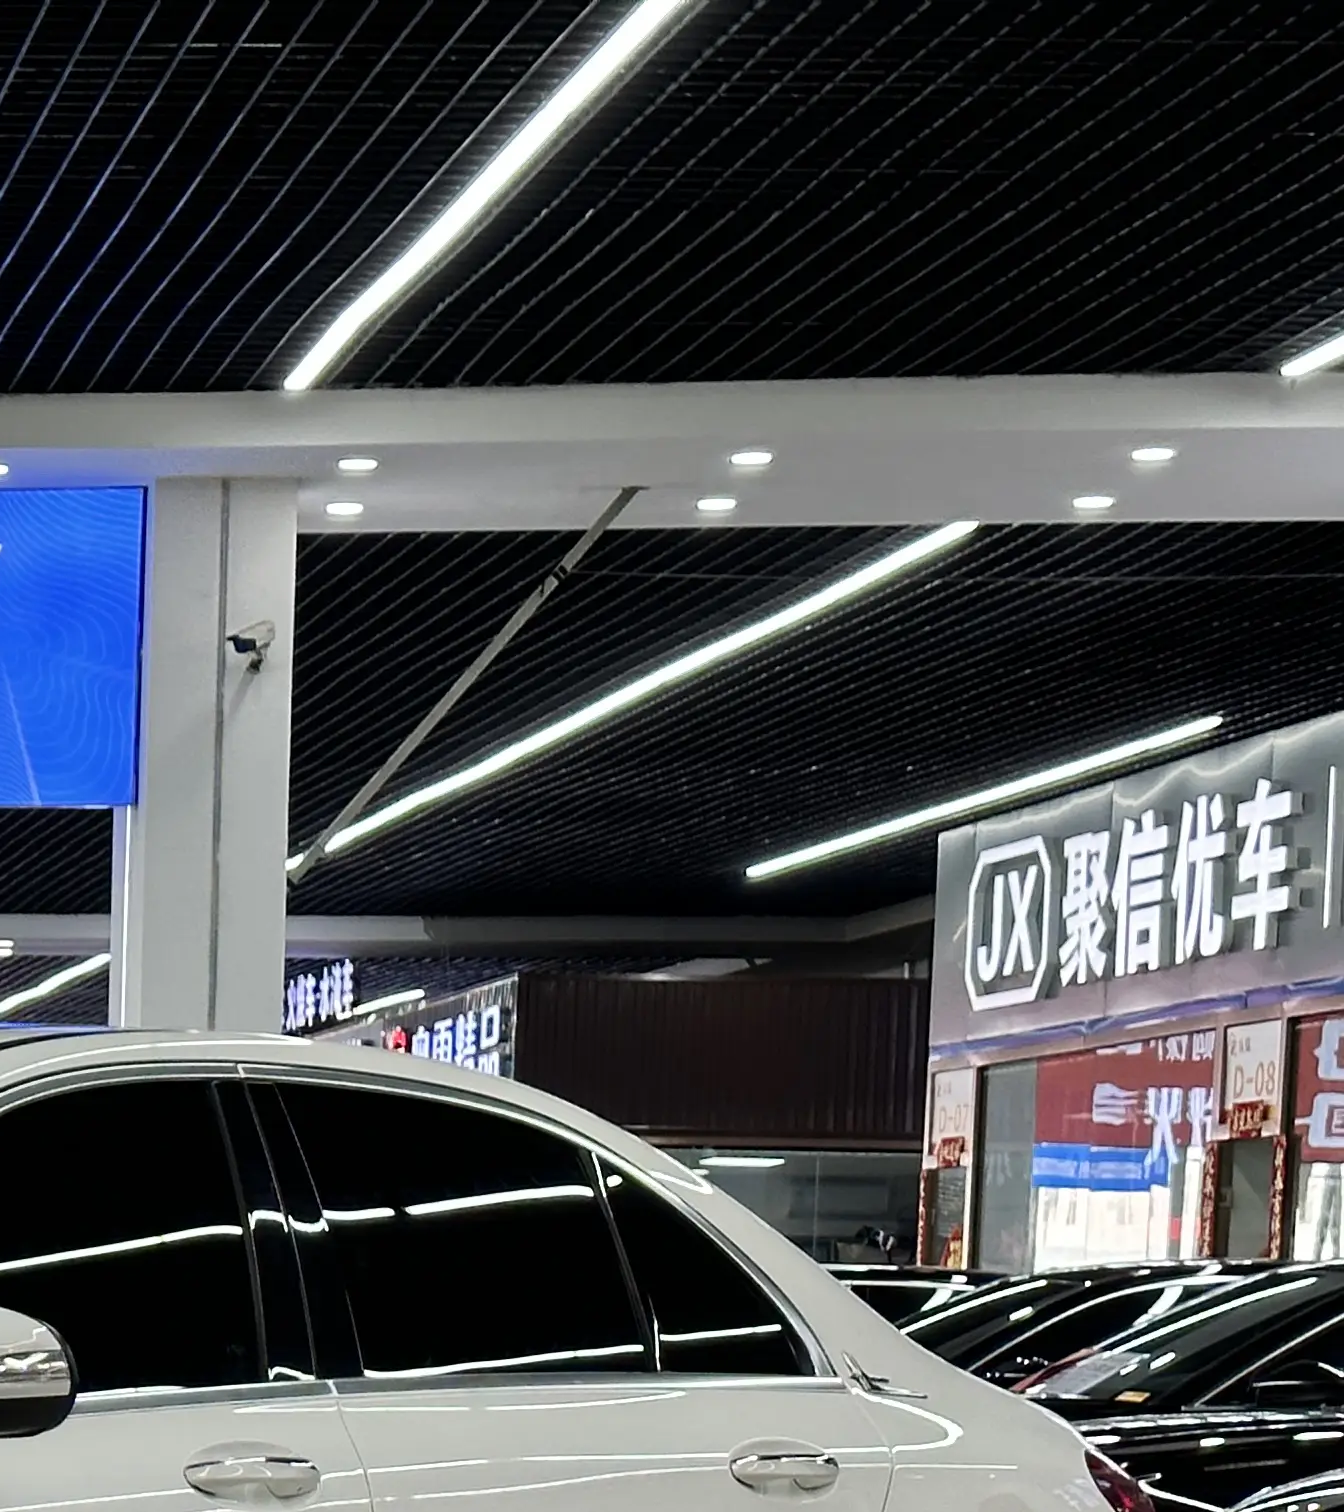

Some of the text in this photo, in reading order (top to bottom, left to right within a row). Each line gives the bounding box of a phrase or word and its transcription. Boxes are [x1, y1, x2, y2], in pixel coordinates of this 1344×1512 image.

[977, 864, 1038, 982] JX
[1058, 778, 1292, 985] 聚信优车
